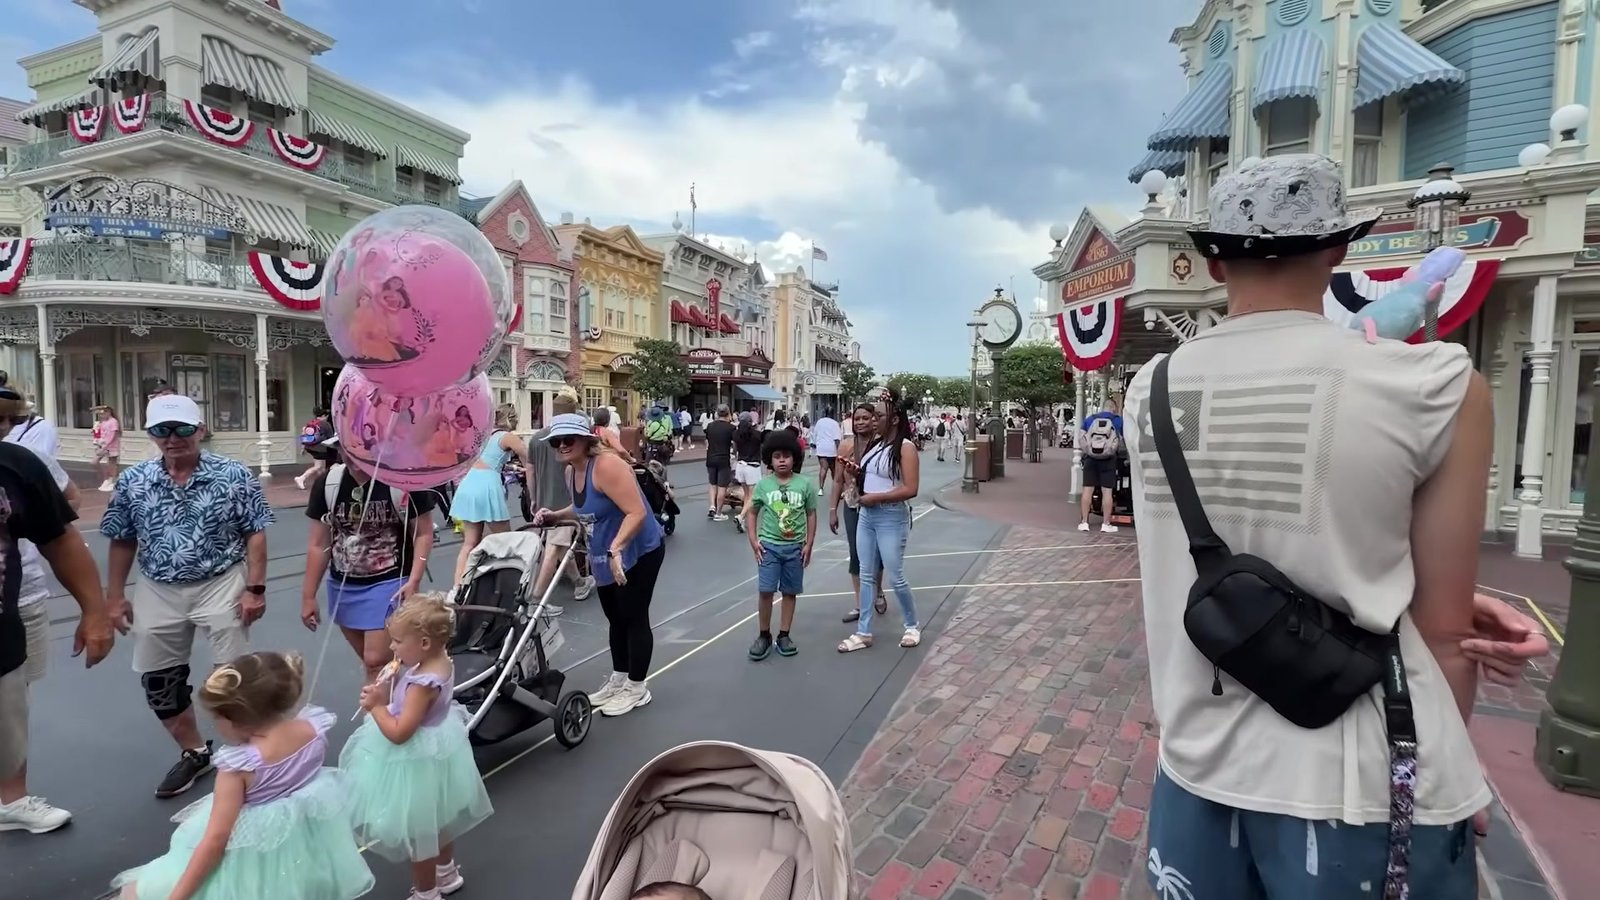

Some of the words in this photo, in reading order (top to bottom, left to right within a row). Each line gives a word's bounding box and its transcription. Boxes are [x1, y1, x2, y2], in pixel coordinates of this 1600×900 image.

[101, 218, 135, 227] CHINA
[148, 221, 216, 236] TIMEPIECES
[1066, 261, 1130, 298] EMPORIUM
